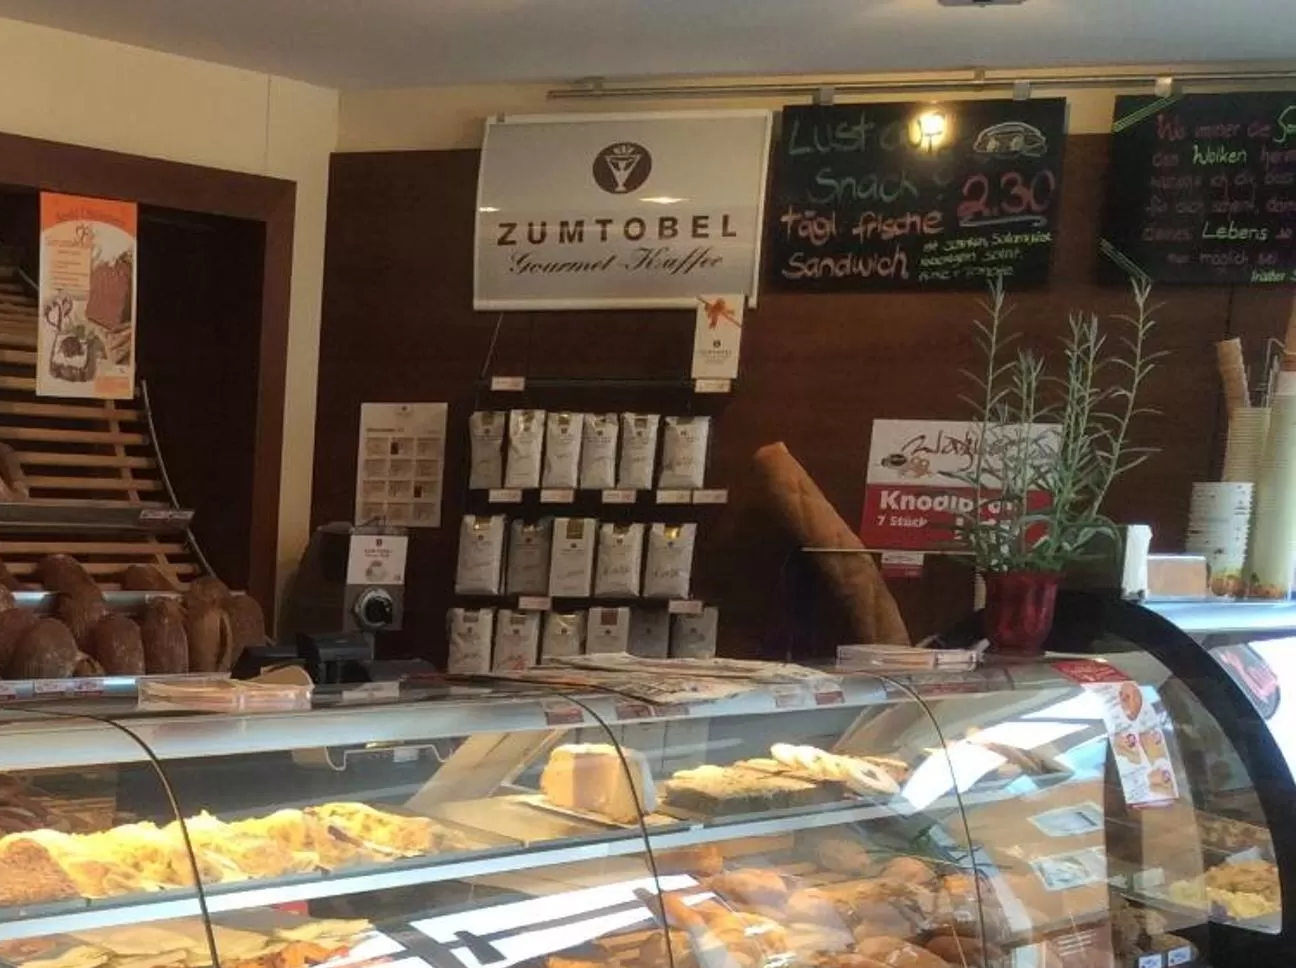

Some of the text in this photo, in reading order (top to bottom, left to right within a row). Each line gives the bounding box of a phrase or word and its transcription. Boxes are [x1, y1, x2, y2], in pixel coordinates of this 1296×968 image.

[788, 111, 875, 155] Lust
[1192, 144, 1248, 166] Wolken
[957, 169, 1054, 217] 2.30
[497, 214, 737, 246] ZUMTOBEL
[853, 210, 945, 244] frische
[1202, 220, 1269, 240] Lebens
[509, 251, 617, 275] Gourmet
[781, 245, 909, 280] Sandwich
